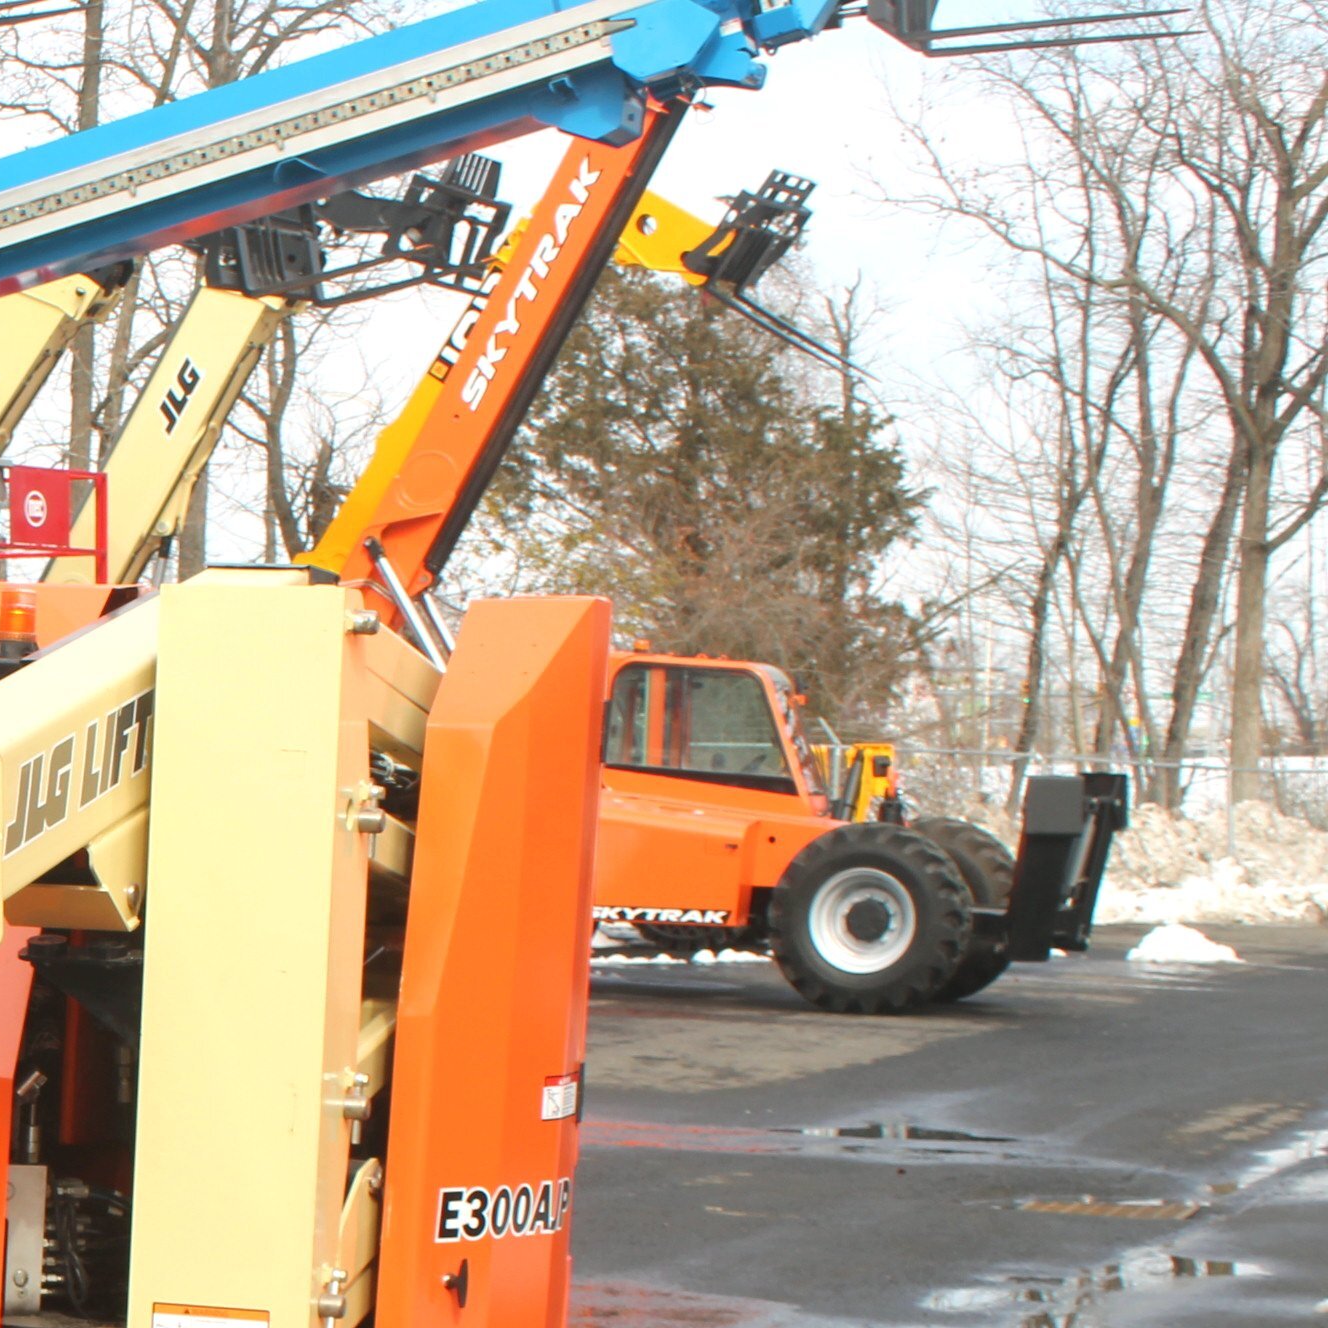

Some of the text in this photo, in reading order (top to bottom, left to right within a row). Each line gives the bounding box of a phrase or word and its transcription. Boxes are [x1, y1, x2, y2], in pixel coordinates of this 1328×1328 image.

[461, 155, 603, 412] SKYTRAK
[159, 357, 201, 435] JLG
[3, 687, 156, 861] JLG LIFT
[592, 905, 727, 924] SKYTRAK
